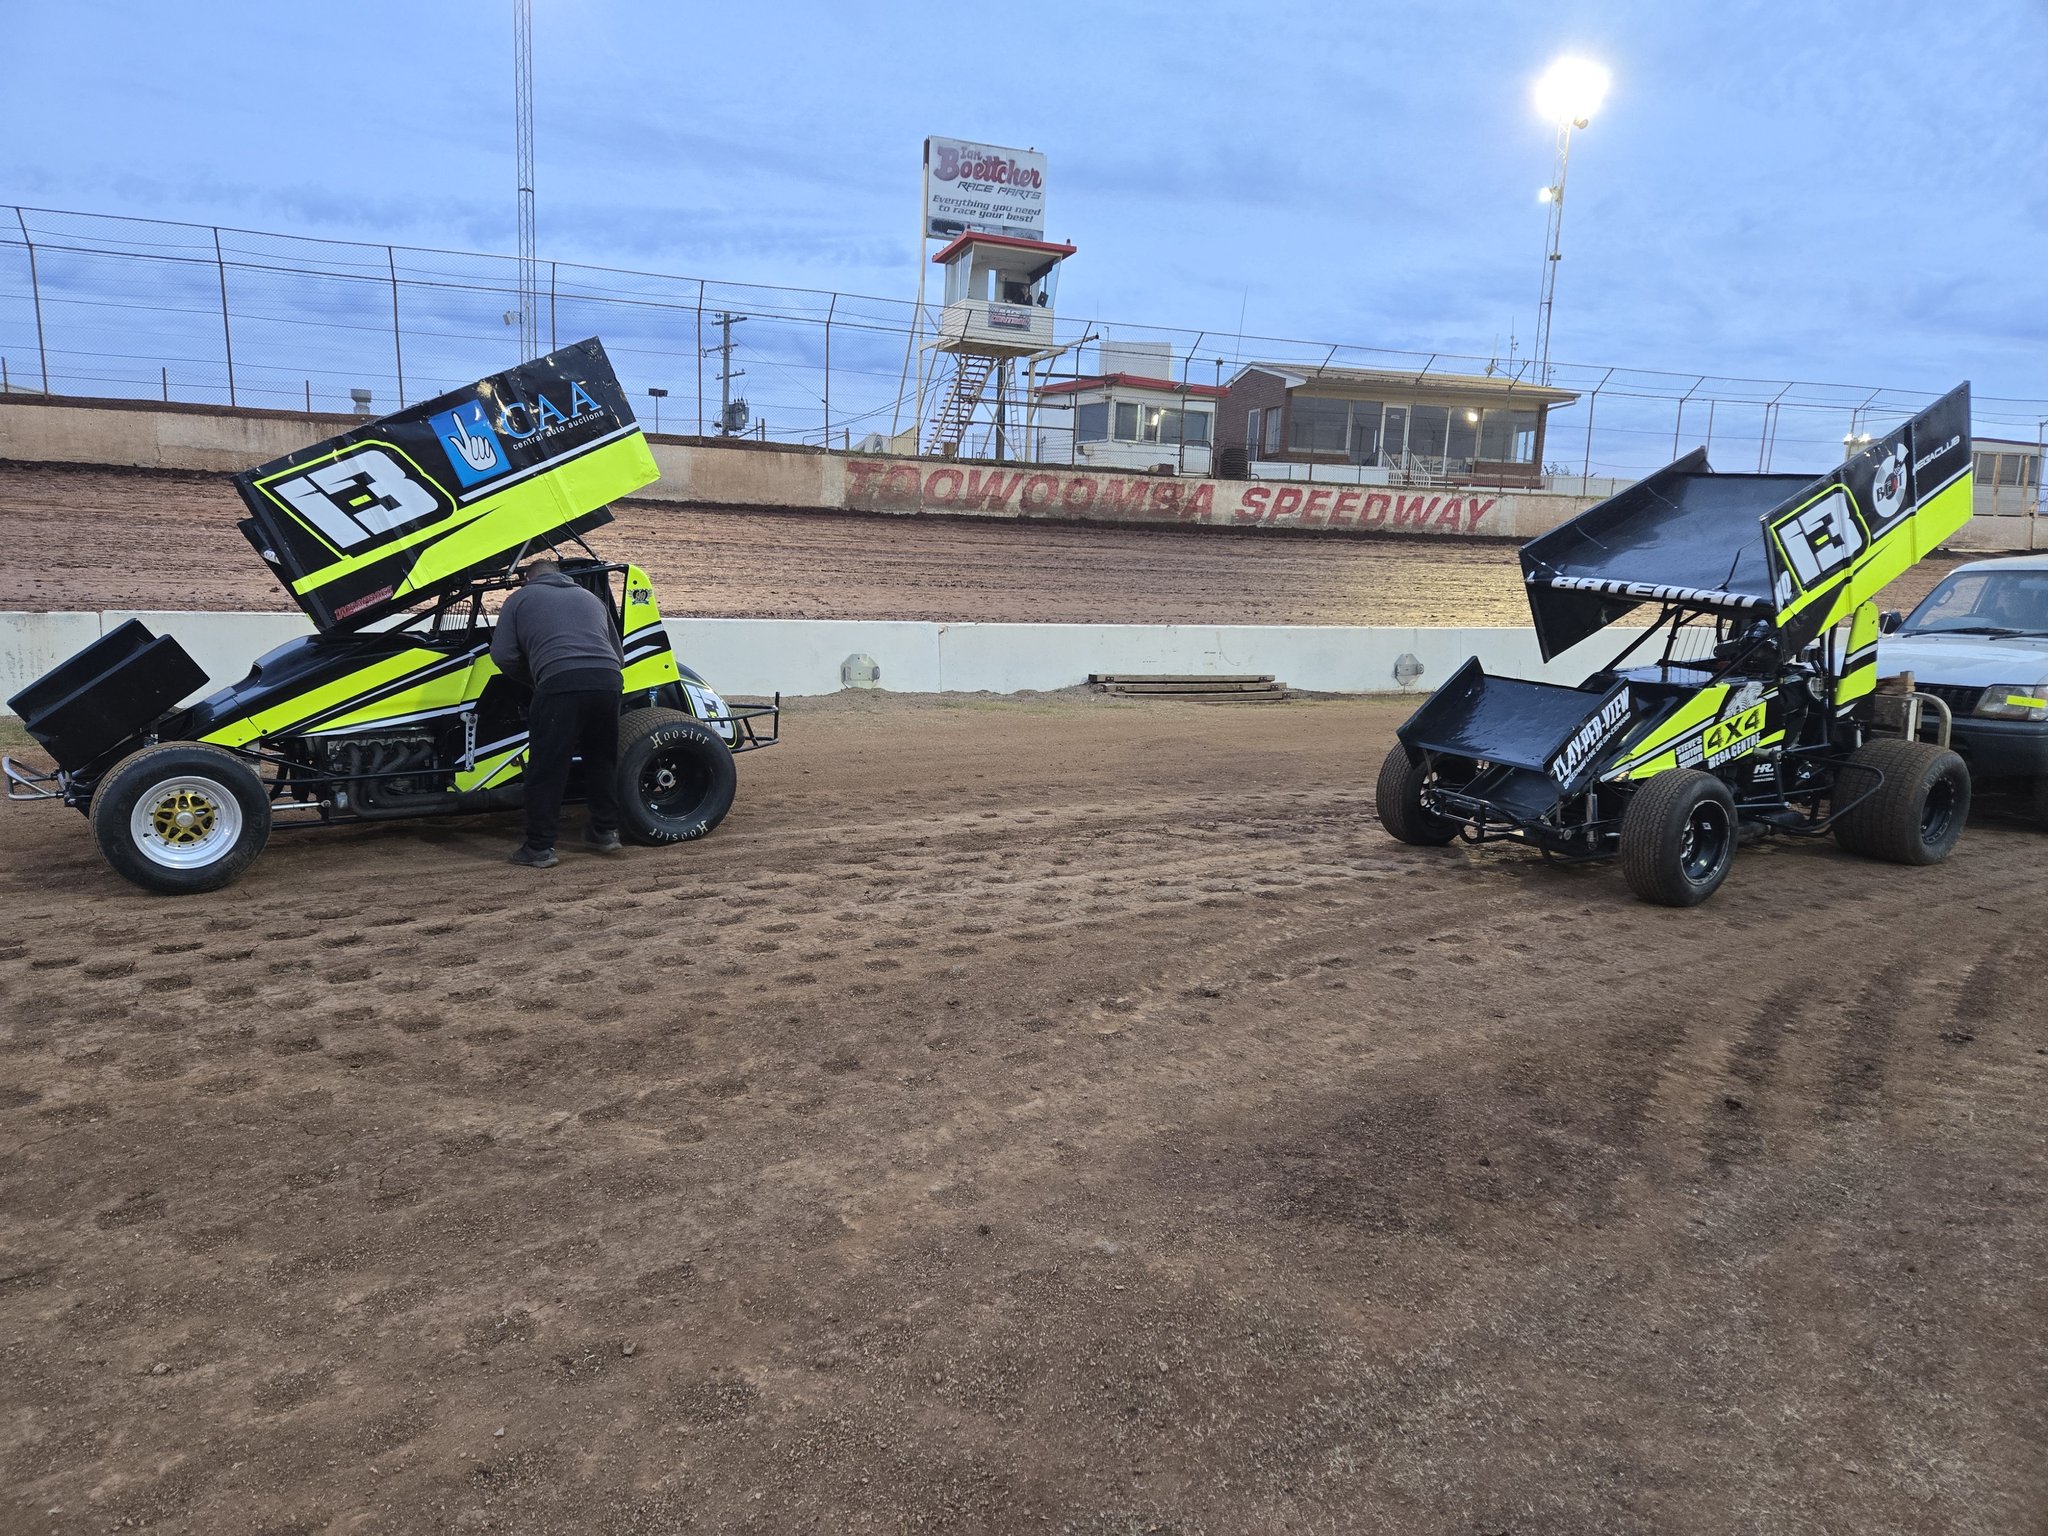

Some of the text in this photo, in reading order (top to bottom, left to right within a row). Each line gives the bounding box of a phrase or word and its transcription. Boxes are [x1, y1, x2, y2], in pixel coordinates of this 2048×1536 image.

[933, 146, 1042, 189] Boettcher
[960, 146, 983, 161] Ian
[932, 194, 1041, 216] Everything you need
[957, 181, 1042, 200] RACE PARTS
[953, 207, 977, 216] race
[979, 210, 1005, 219] your
[1006, 212, 1034, 223] best!
[500, 381, 602, 439] CAA
[512, 409, 604, 451] central auto auctions
[272, 450, 439, 549] 13
[847, 461, 1496, 532] TOOWOOMBA SPEEDWAY
[1778, 492, 1863, 585] 13
[1551, 576, 1762, 608] BATEMAN
[649, 728, 710, 749] Hoosier
[1552, 686, 1630, 782] CLAY-PER-VIEW
[1707, 708, 1760, 750] 4X4
[1730, 732, 1761, 757] CENTRE
[649, 820, 709, 842] Hoosier
